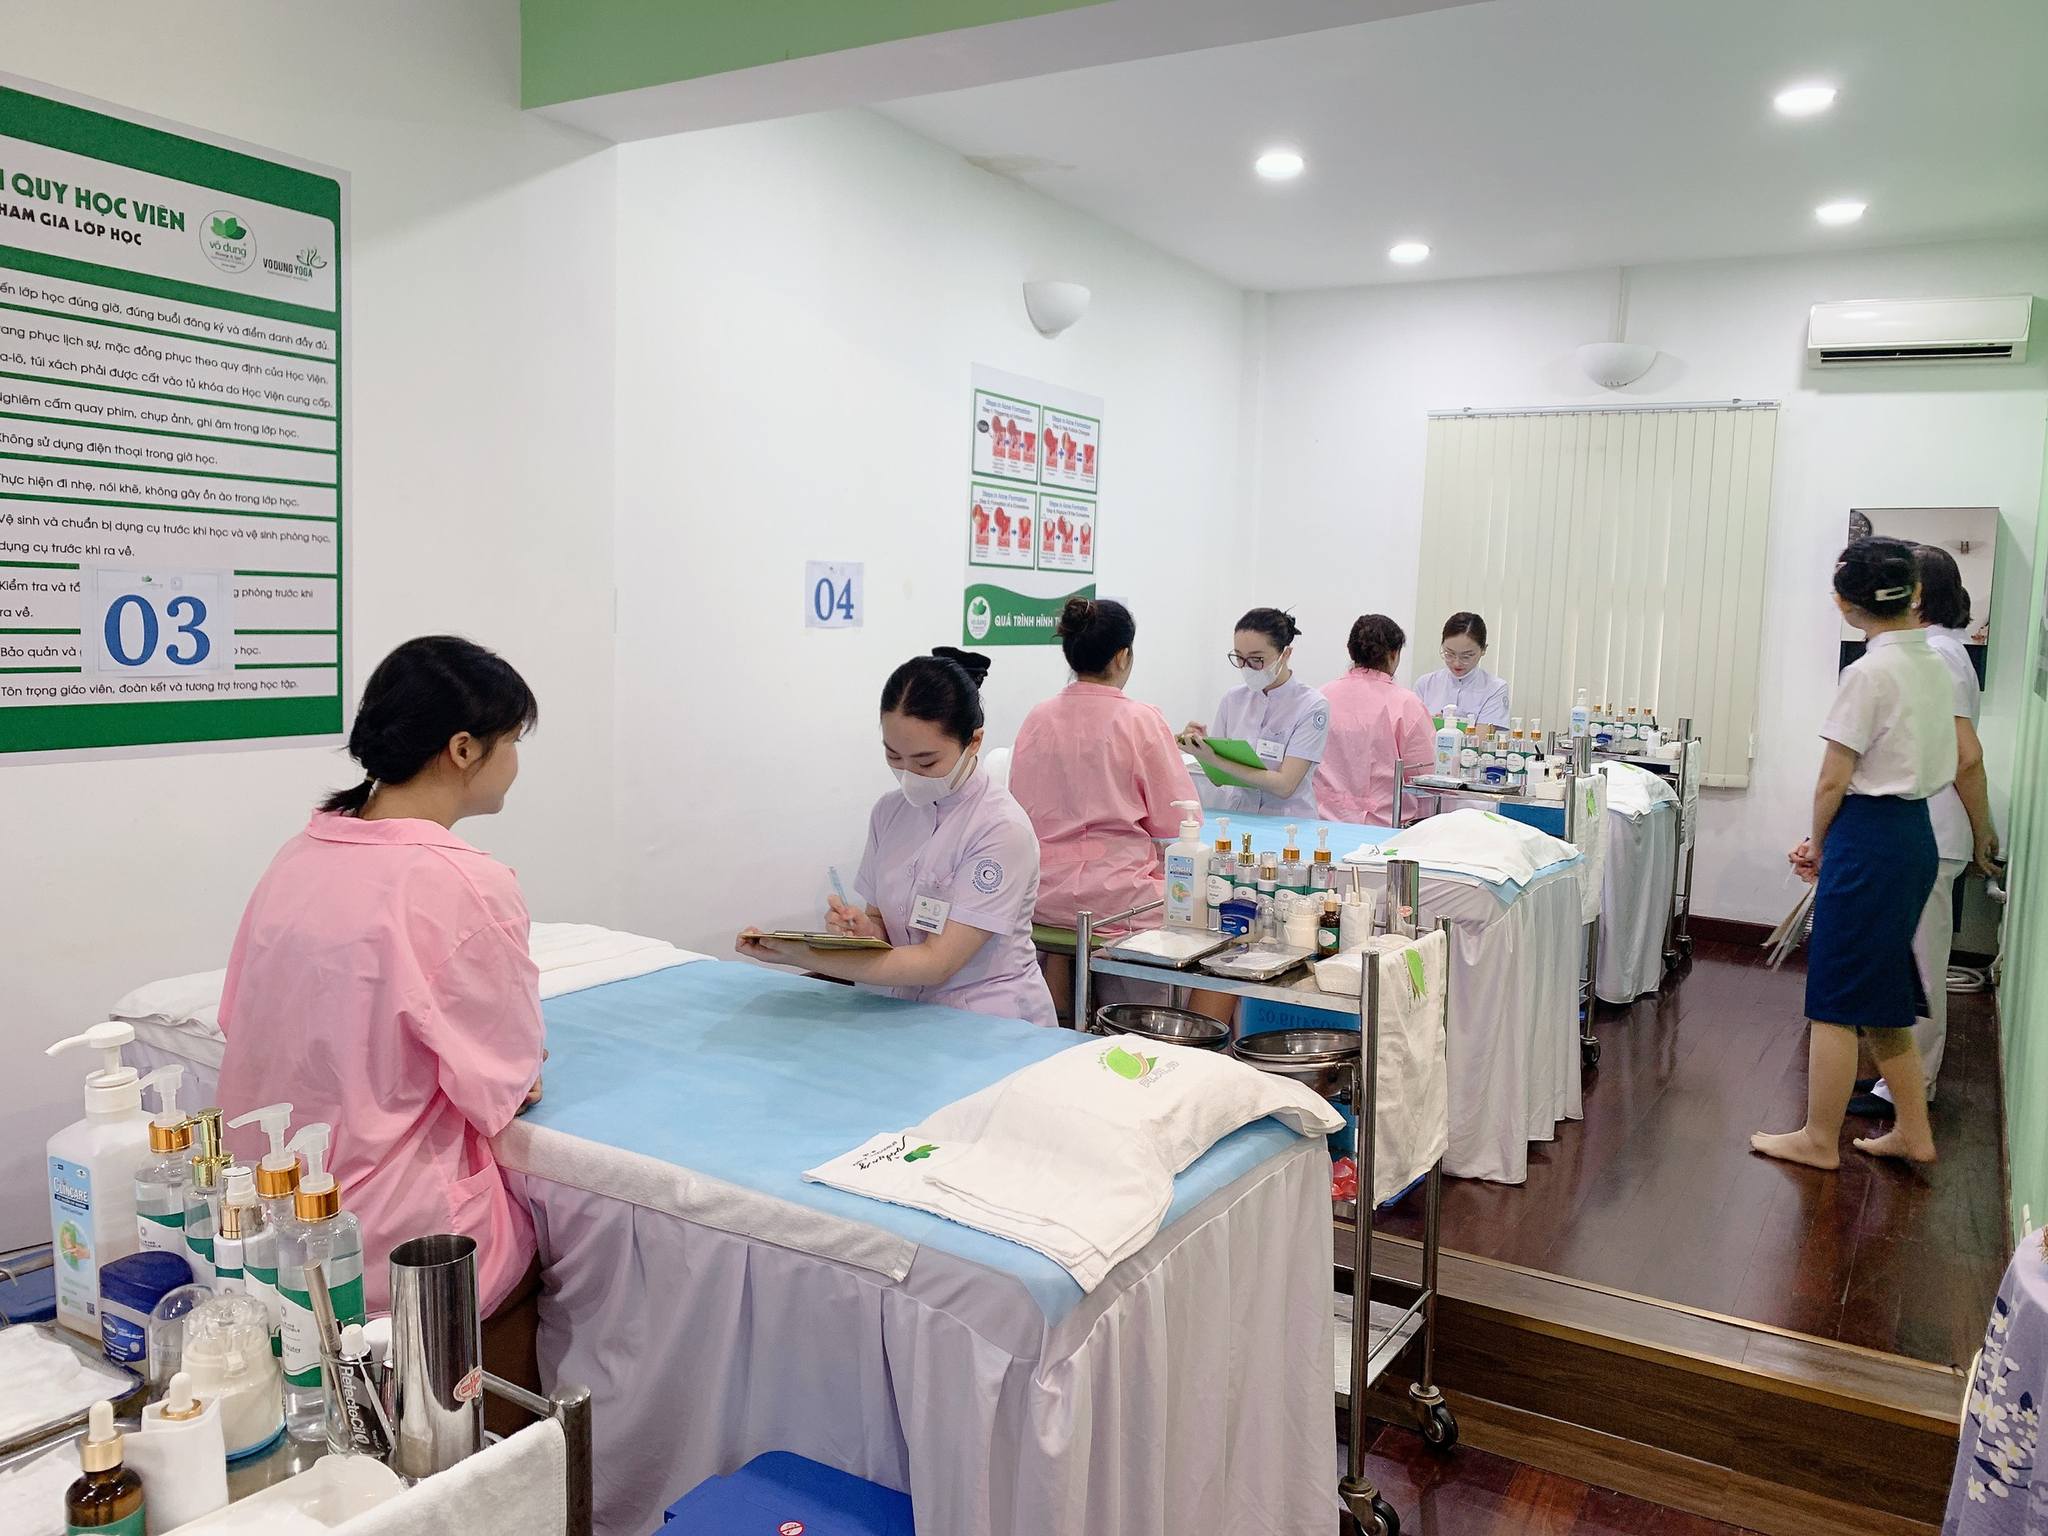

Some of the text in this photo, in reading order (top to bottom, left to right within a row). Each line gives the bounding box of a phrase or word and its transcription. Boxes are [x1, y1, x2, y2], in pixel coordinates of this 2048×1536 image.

[12, 173, 68, 204] QUY
[75, 187, 128, 219] HỌC
[133, 201, 185, 232] VIÊN
[0, 204, 142, 246] HAM GIA LỚP HỌC
[223, 243, 247, 258] dung
[294, 265, 313, 278] YOGA
[0, 282, 15, 294] ến
[19, 286, 38, 300] lớp
[42, 290, 64, 304] học
[69, 296, 98, 311] đúng
[126, 304, 154, 321] đúng
[158, 312, 180, 326] buổi
[214, 320, 224, 334] ký
[227, 325, 239, 336] và
[1, 326, 25, 339] ang
[29, 330, 59, 343] phục
[64, 334, 83, 347] lịch
[105, 343, 130, 355] mặc
[134, 344, 161, 360] đồng
[165, 352, 191, 364] phục
[195, 355, 217, 368] theo
[221, 361, 238, 374] quy
[0, 353, 26, 365] a-lô,
[31, 356, 45, 367] túi
[49, 359, 77, 375] xách
[81, 364, 106, 376] phải
[110, 368, 138, 383] được
[141, 370, 159, 383] cất
[163, 376, 182, 389] vào
[186, 378, 195, 389] tủ
[199, 380, 223, 393] khóa
[226, 384, 239, 397] do
[45, 398, 71, 410] cấm
[75, 402, 103, 419] quay
[141, 408, 168, 423] chụp
[197, 416, 212, 428] ghi
[215, 417, 231, 431] âm
[37, 436, 50, 447] sử
[53, 439, 83, 453] dụng
[86, 441, 111, 456] điện
[115, 445, 142, 458] thoại
[146, 448, 173, 462] trong
[177, 452, 192, 464] giờ
[196, 453, 218, 465] học.
[28, 476, 53, 488] hiện
[57, 479, 67, 488] đi
[100, 480, 116, 495] nói
[145, 485, 177, 499] không
[181, 488, 200, 501] gây
[219, 491, 232, 504] ào
[0, 514, 13, 526] Vệ
[17, 515, 39, 525] sinh
[43, 517, 58, 526] và
[62, 517, 98, 529] chuẩn
[102, 520, 112, 532] bị
[115, 520, 143, 534] dụng
[147, 522, 160, 536] cụ
[164, 524, 190, 536] trước
[193, 526, 207, 536] khi
[210, 527, 228, 538] học
[0, 541, 135, 558] dụng cụ trước khi ra về.
[0, 577, 28, 591] Kiểm
[33, 581, 48, 592] tra
[51, 582, 66, 592] và
[0, 606, 33, 617] ra về.
[814, 577, 855, 621] 04
[104, 594, 211, 666] 03
[995, 612, 1012, 627] QUÁ
[1013, 613, 1034, 627] TRÌNH
[1036, 613, 1053, 627] HÌNH
[1, 646, 24, 659] Bảo
[28, 646, 58, 658] quản
[62, 646, 76, 656] và
[1, 686, 22, 696] Tôn
[26, 686, 57, 697] trọng
[61, 685, 86, 697] giáo
[90, 682, 115, 695] viên,
[119, 680, 147, 696] đoàn
[151, 681, 166, 695] kết
[169, 680, 182, 696] và
[185, 680, 214, 695] tương
[218, 680, 230, 693] trợ
